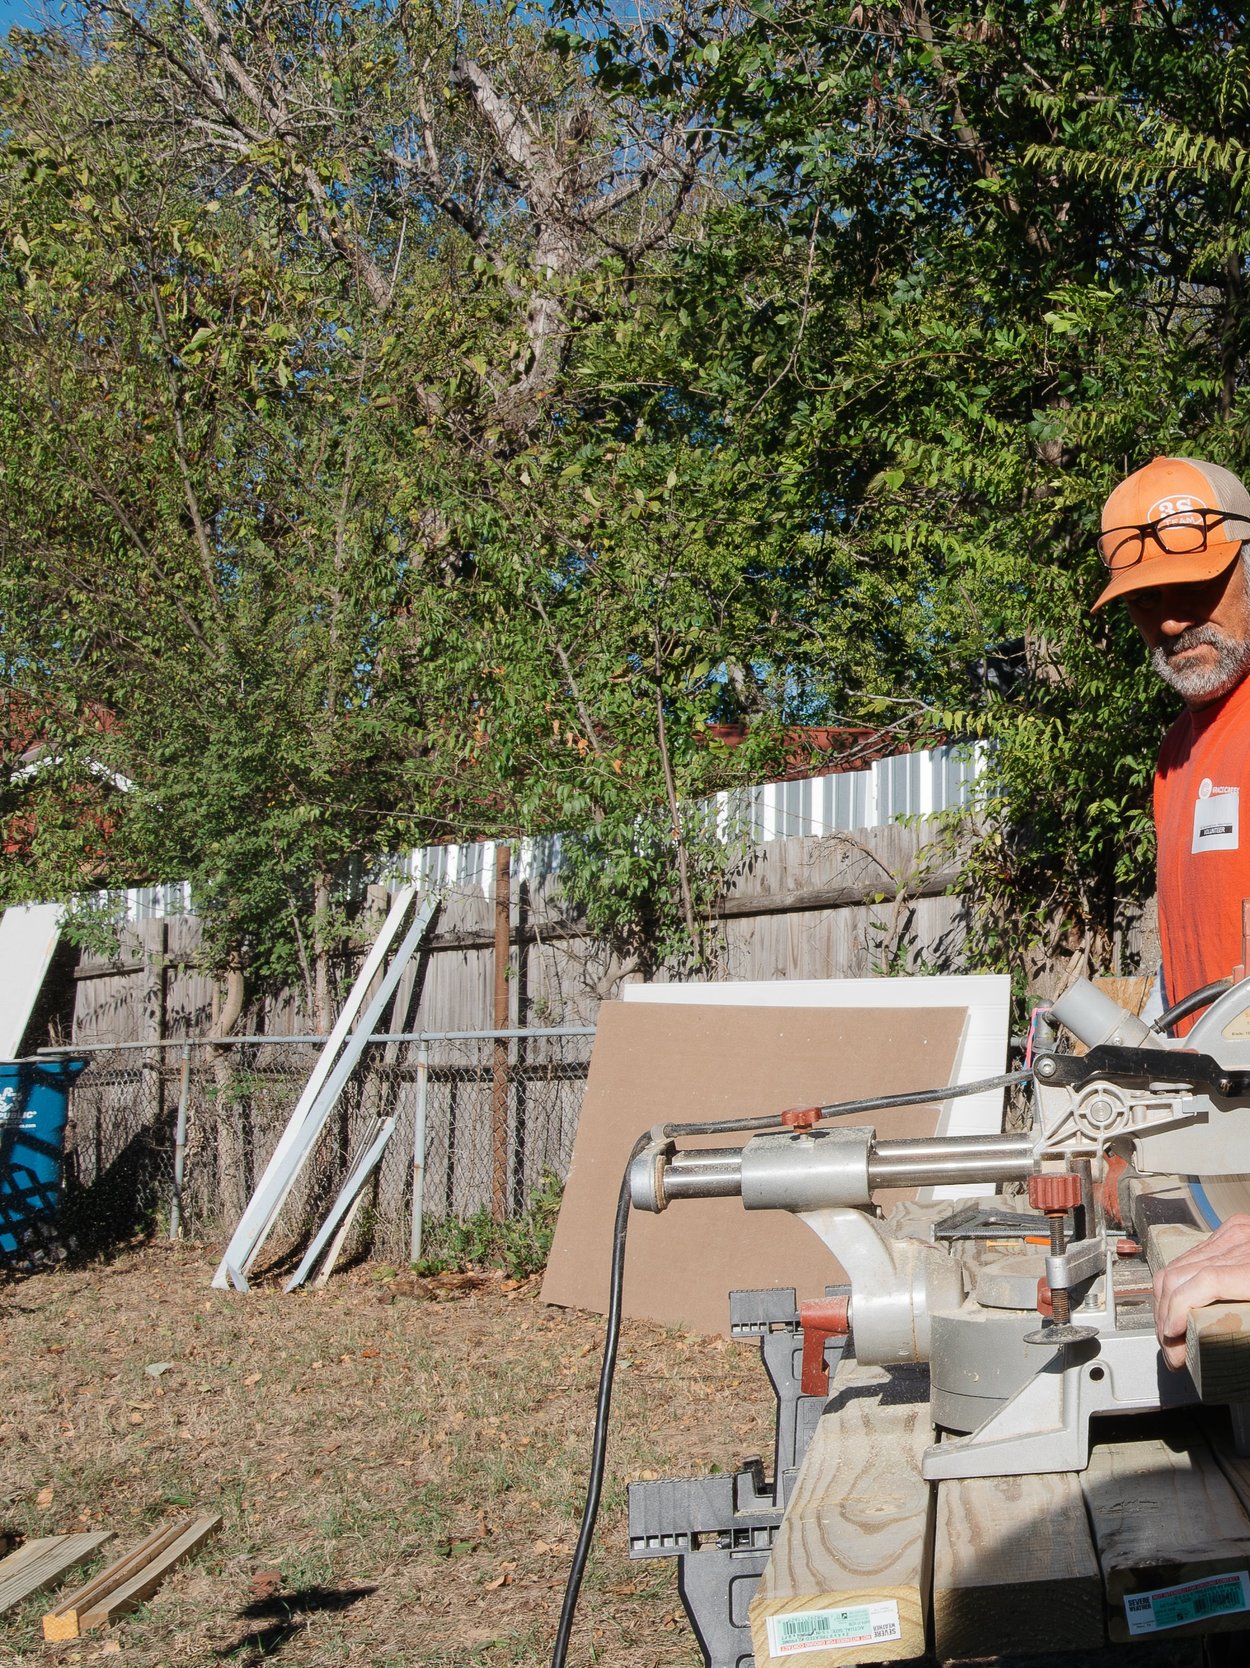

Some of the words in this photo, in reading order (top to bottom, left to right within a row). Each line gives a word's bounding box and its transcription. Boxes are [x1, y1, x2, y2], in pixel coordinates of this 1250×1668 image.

[1128, 1596, 1150, 1606] SEVERE
[1129, 1603, 1152, 1612] WEATHER
[872, 1622, 896, 1631] WEATHER
[874, 1627, 897, 1638] SEVERE
